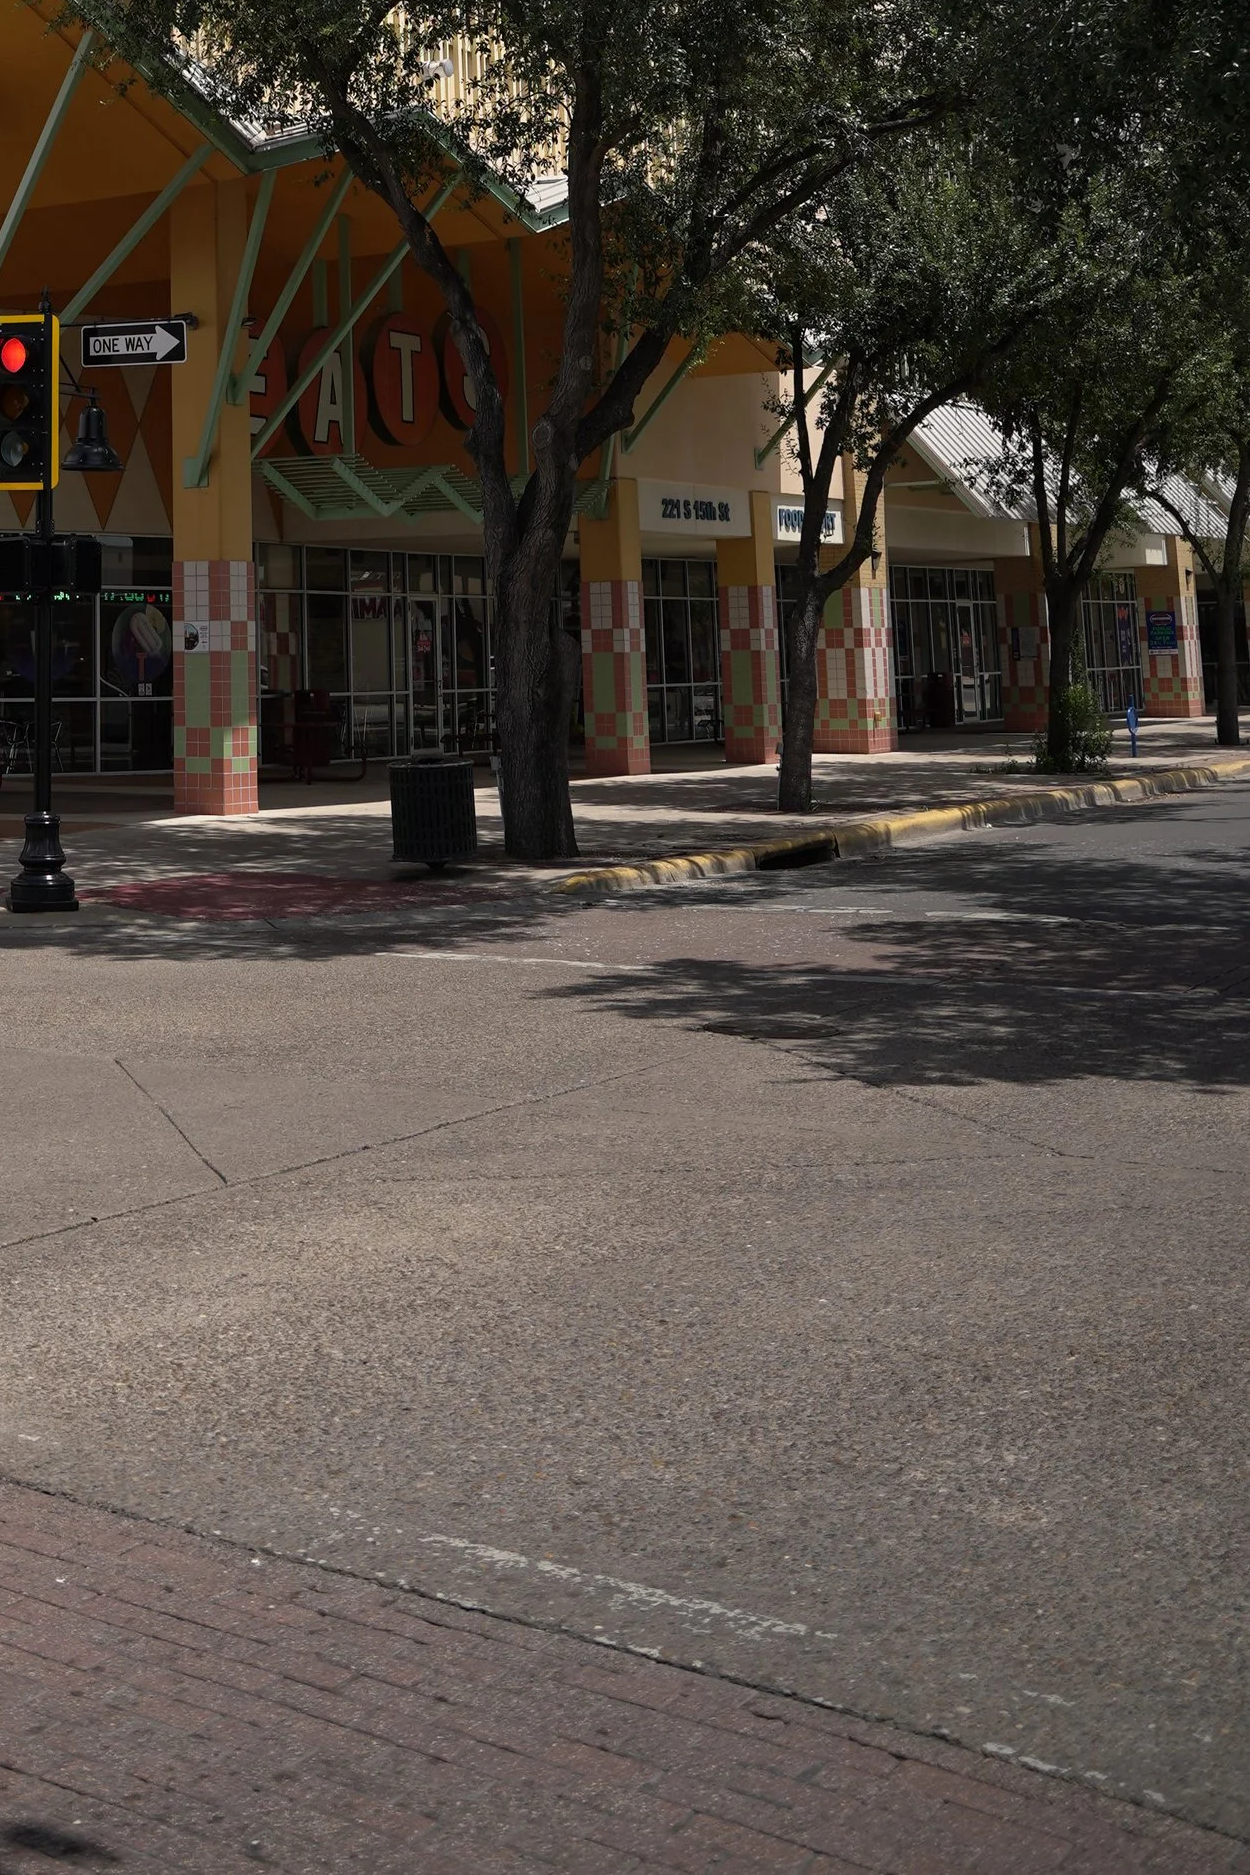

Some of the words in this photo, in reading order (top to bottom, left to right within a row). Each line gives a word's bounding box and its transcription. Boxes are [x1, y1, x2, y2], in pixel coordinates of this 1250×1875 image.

[93, 338, 119, 353] ONE
[125, 336, 153, 351] WAY
[661, 498, 680, 519] 221
[683, 500, 691, 520] S
[693, 500, 716, 521] 15th
[718, 502, 730, 522] St
